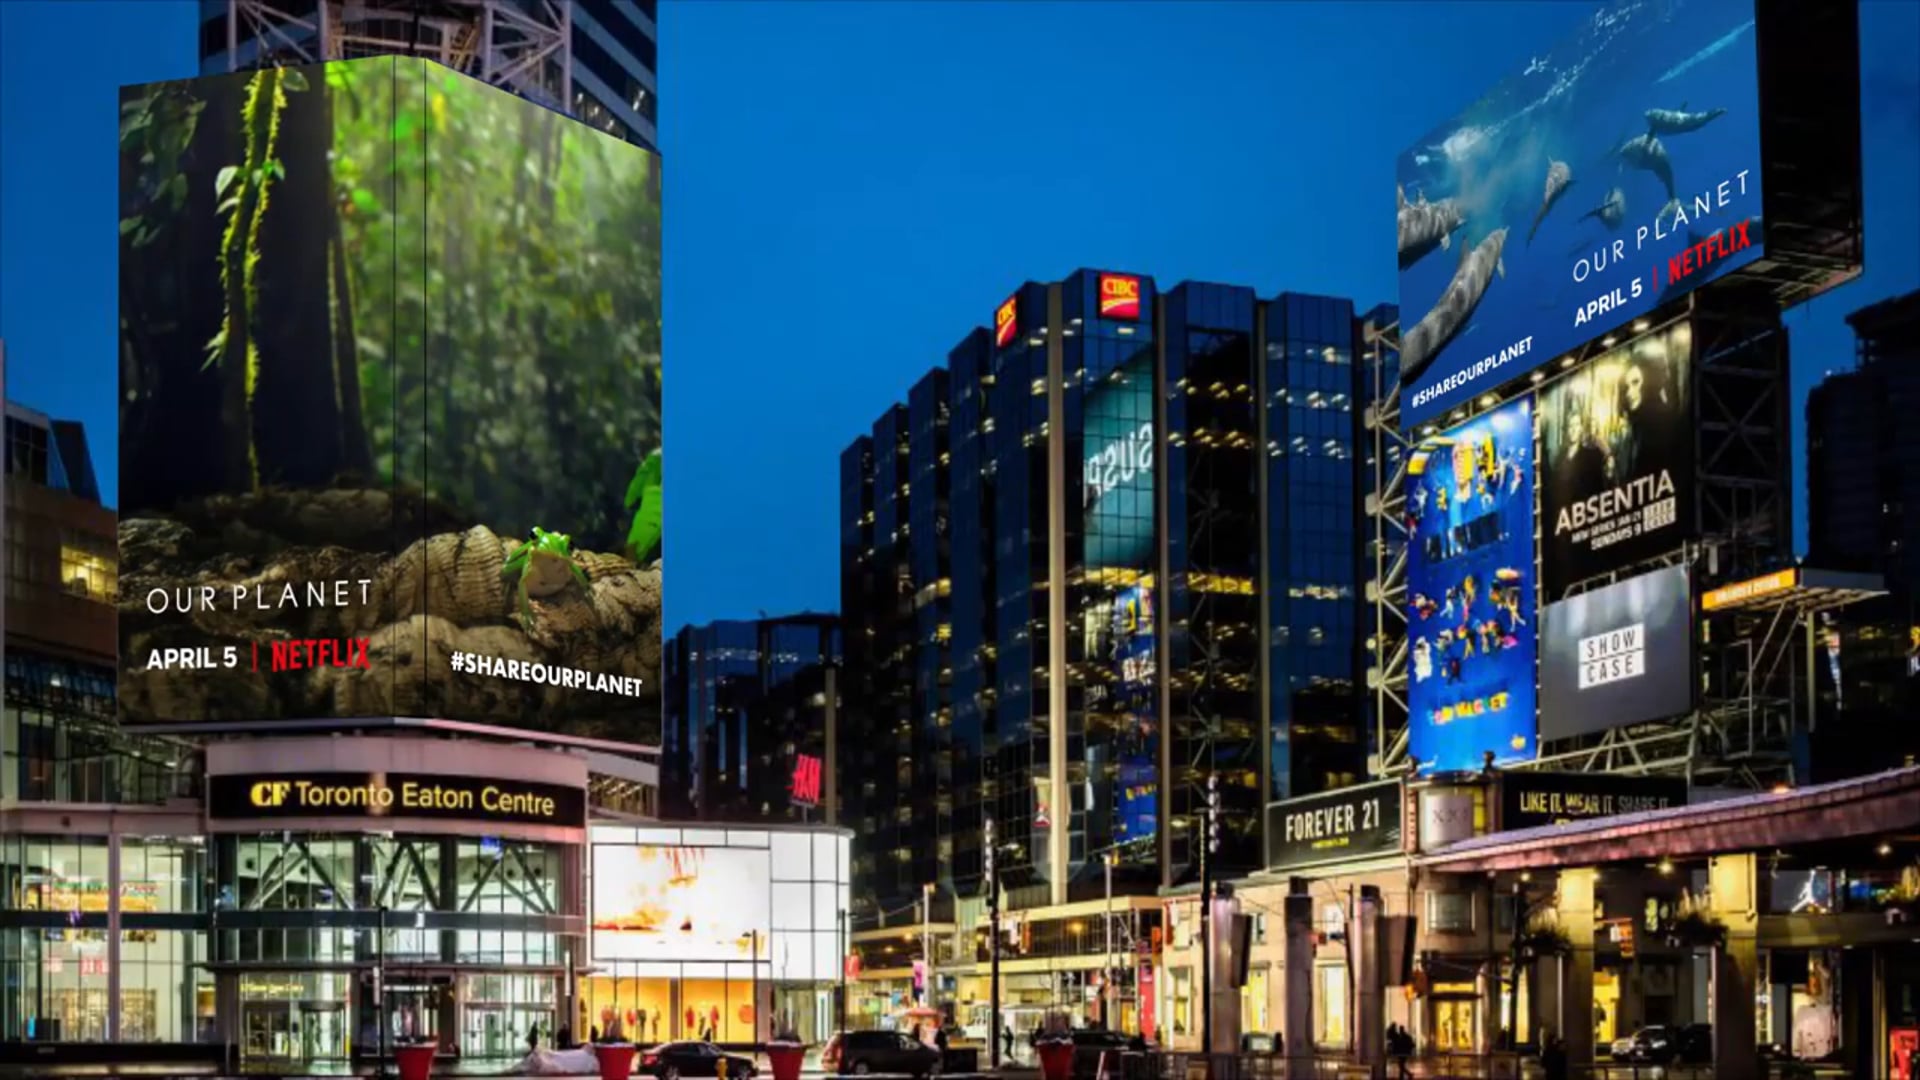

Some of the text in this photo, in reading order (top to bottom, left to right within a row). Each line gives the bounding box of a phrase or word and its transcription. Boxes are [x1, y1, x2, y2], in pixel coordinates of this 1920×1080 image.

[1572, 170, 1749, 282] OUR PLANET
[1102, 278, 1139, 298] CIBC
[1574, 220, 1751, 327] APRIL 5 NETFLIX
[1412, 336, 1533, 408] #SHAREOURPLANET
[1555, 469, 1675, 536] ABSENTIA
[146, 579, 372, 614] OUR PLANET
[146, 637, 371, 672] APRIL 5 NETFLIX
[1587, 629, 1636, 659] SHOW
[451, 651, 643, 697] #SHAREOURPLANET
[1587, 654, 1634, 683] CASE
[250, 781, 556, 816] CF Toronto Eaton Centre
[1519, 791, 1547, 813] LIKE
[1285, 799, 1380, 843] FOREVER 21
